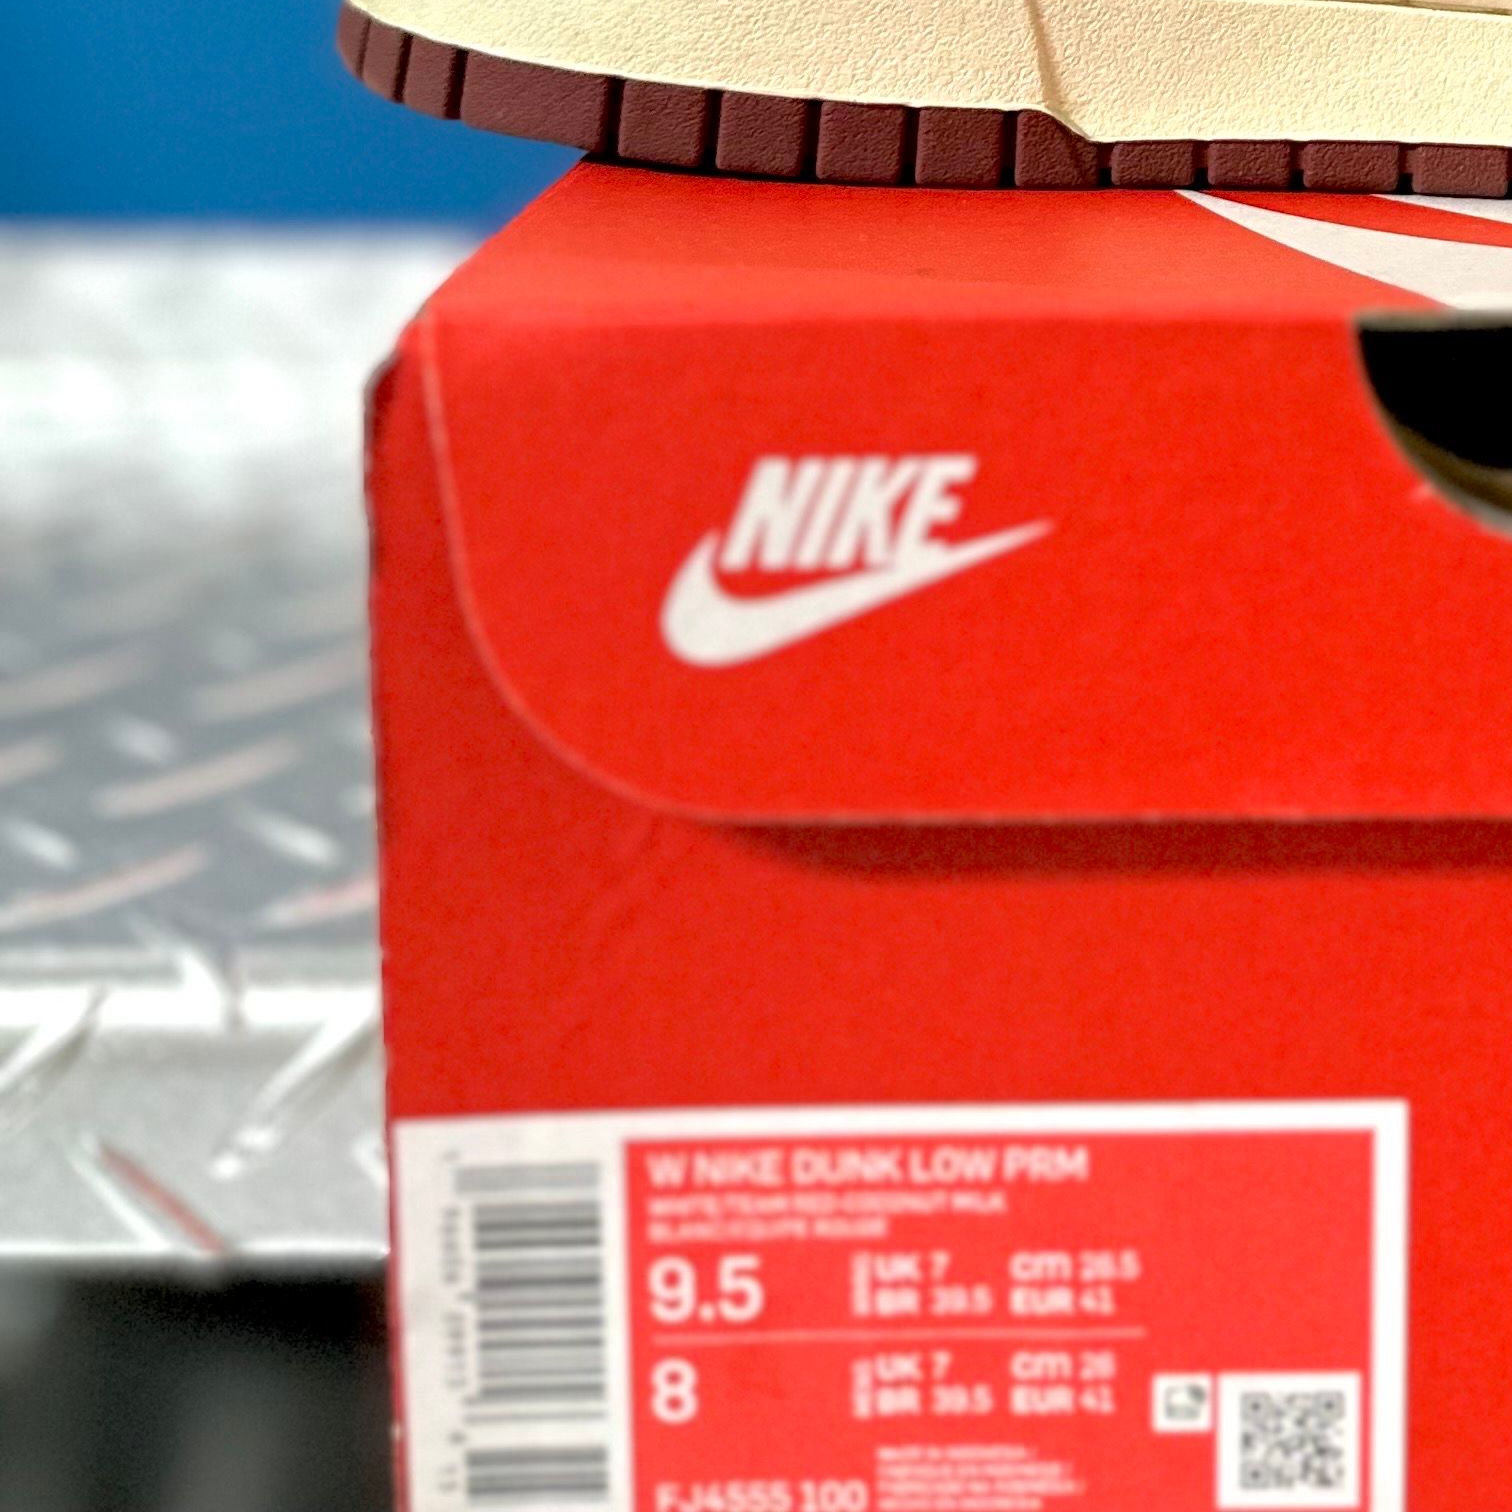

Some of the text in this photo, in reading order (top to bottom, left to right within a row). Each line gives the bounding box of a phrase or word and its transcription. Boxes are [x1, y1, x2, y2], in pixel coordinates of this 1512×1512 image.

[720, 454, 978, 572] NIKE
[647, 1144, 1088, 1187] W NIKE DUNK LOW PRM
[875, 1253, 921, 1281] UK
[929, 1252, 950, 1280] 7
[1009, 1251, 1071, 1281] cm
[648, 1253, 765, 1323] 9.5
[874, 1287, 921, 1316] BR
[1009, 1286, 1074, 1316] EUR
[1078, 1286, 1114, 1316] 41
[875, 1353, 921, 1381] UK
[929, 1352, 950, 1380] 7
[1009, 1351, 1071, 1380] cm
[650, 1358, 698, 1424] 8
[874, 1387, 921, 1415] BR
[1009, 1386, 1074, 1414] EUR
[1078, 1386, 1114, 1414] 41
[655, 1481, 791, 1512] FJ4555
[801, 1479, 869, 1512] 100
